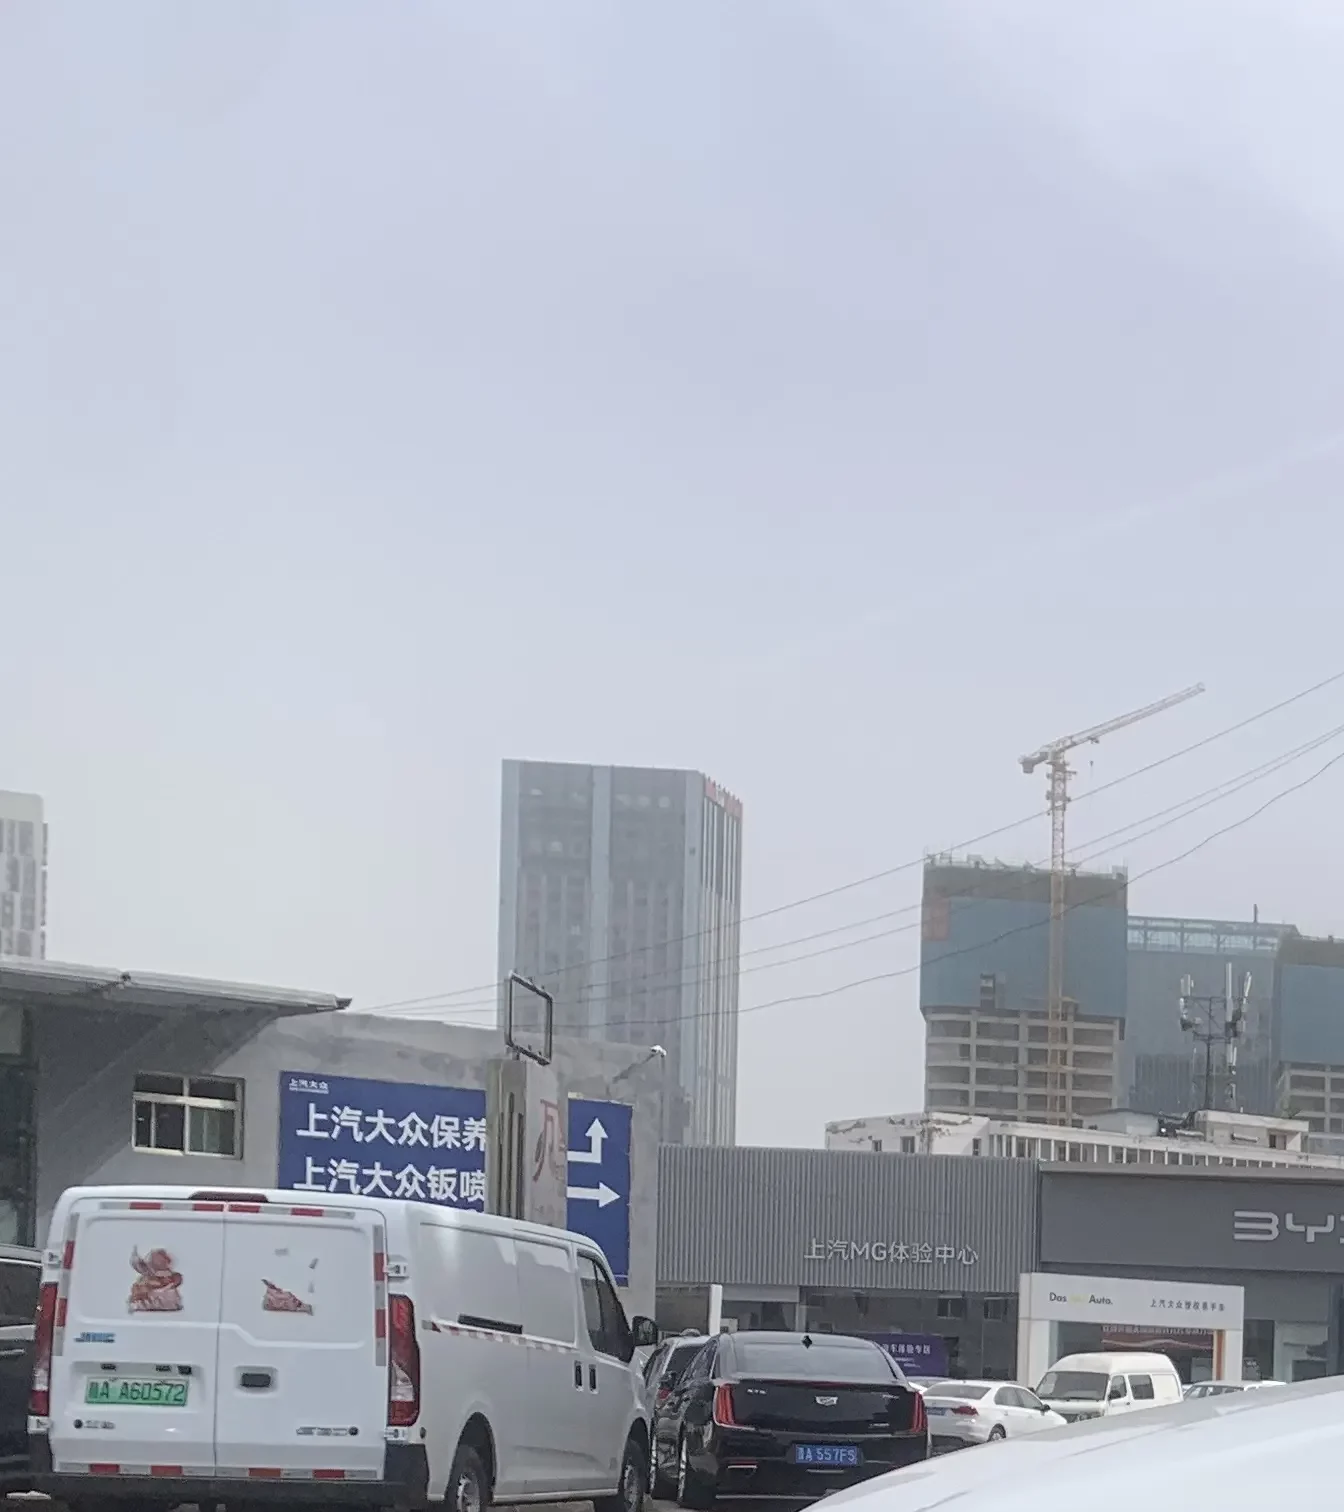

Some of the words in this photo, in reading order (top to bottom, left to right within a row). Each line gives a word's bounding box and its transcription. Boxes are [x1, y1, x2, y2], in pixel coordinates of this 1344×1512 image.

[289, 1078, 328, 1090] 上汽大众
[296, 1102, 486, 1151] 上汽大众保养
[293, 1156, 485, 1202] 上汽大众钣喷
[804, 1237, 979, 1265] 上汽MG体验中心
[1049, 1292, 1068, 1302] Das
